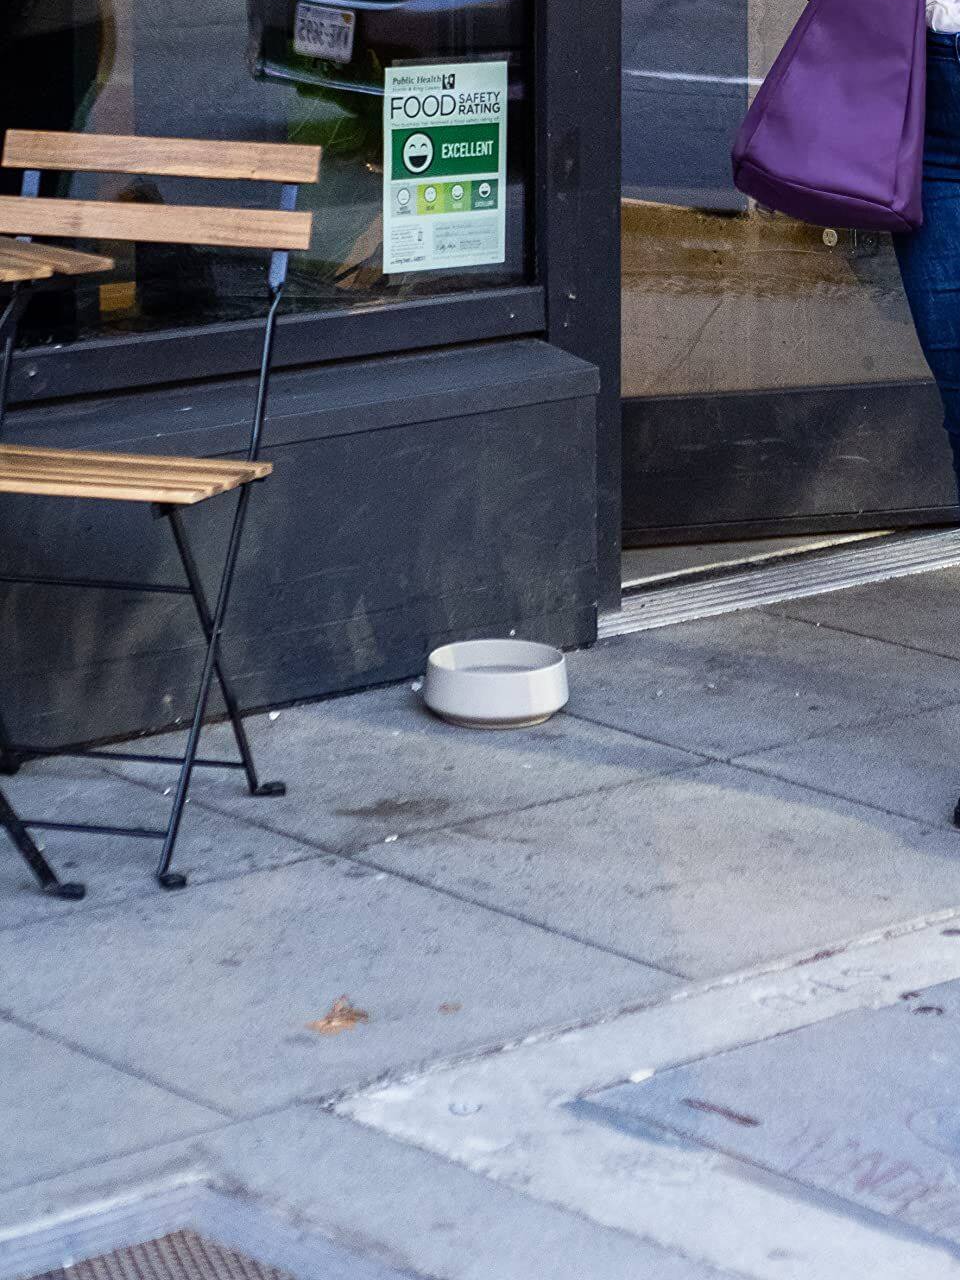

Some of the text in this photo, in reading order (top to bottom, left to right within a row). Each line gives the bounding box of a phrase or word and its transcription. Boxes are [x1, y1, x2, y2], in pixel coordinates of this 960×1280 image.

[391, 74, 442, 86] Public Health
[459, 91, 501, 104] SAFETY
[390, 94, 457, 120] FOOD
[459, 102, 501, 116] RATING
[441, 140, 495, 159] EXCELLENT
